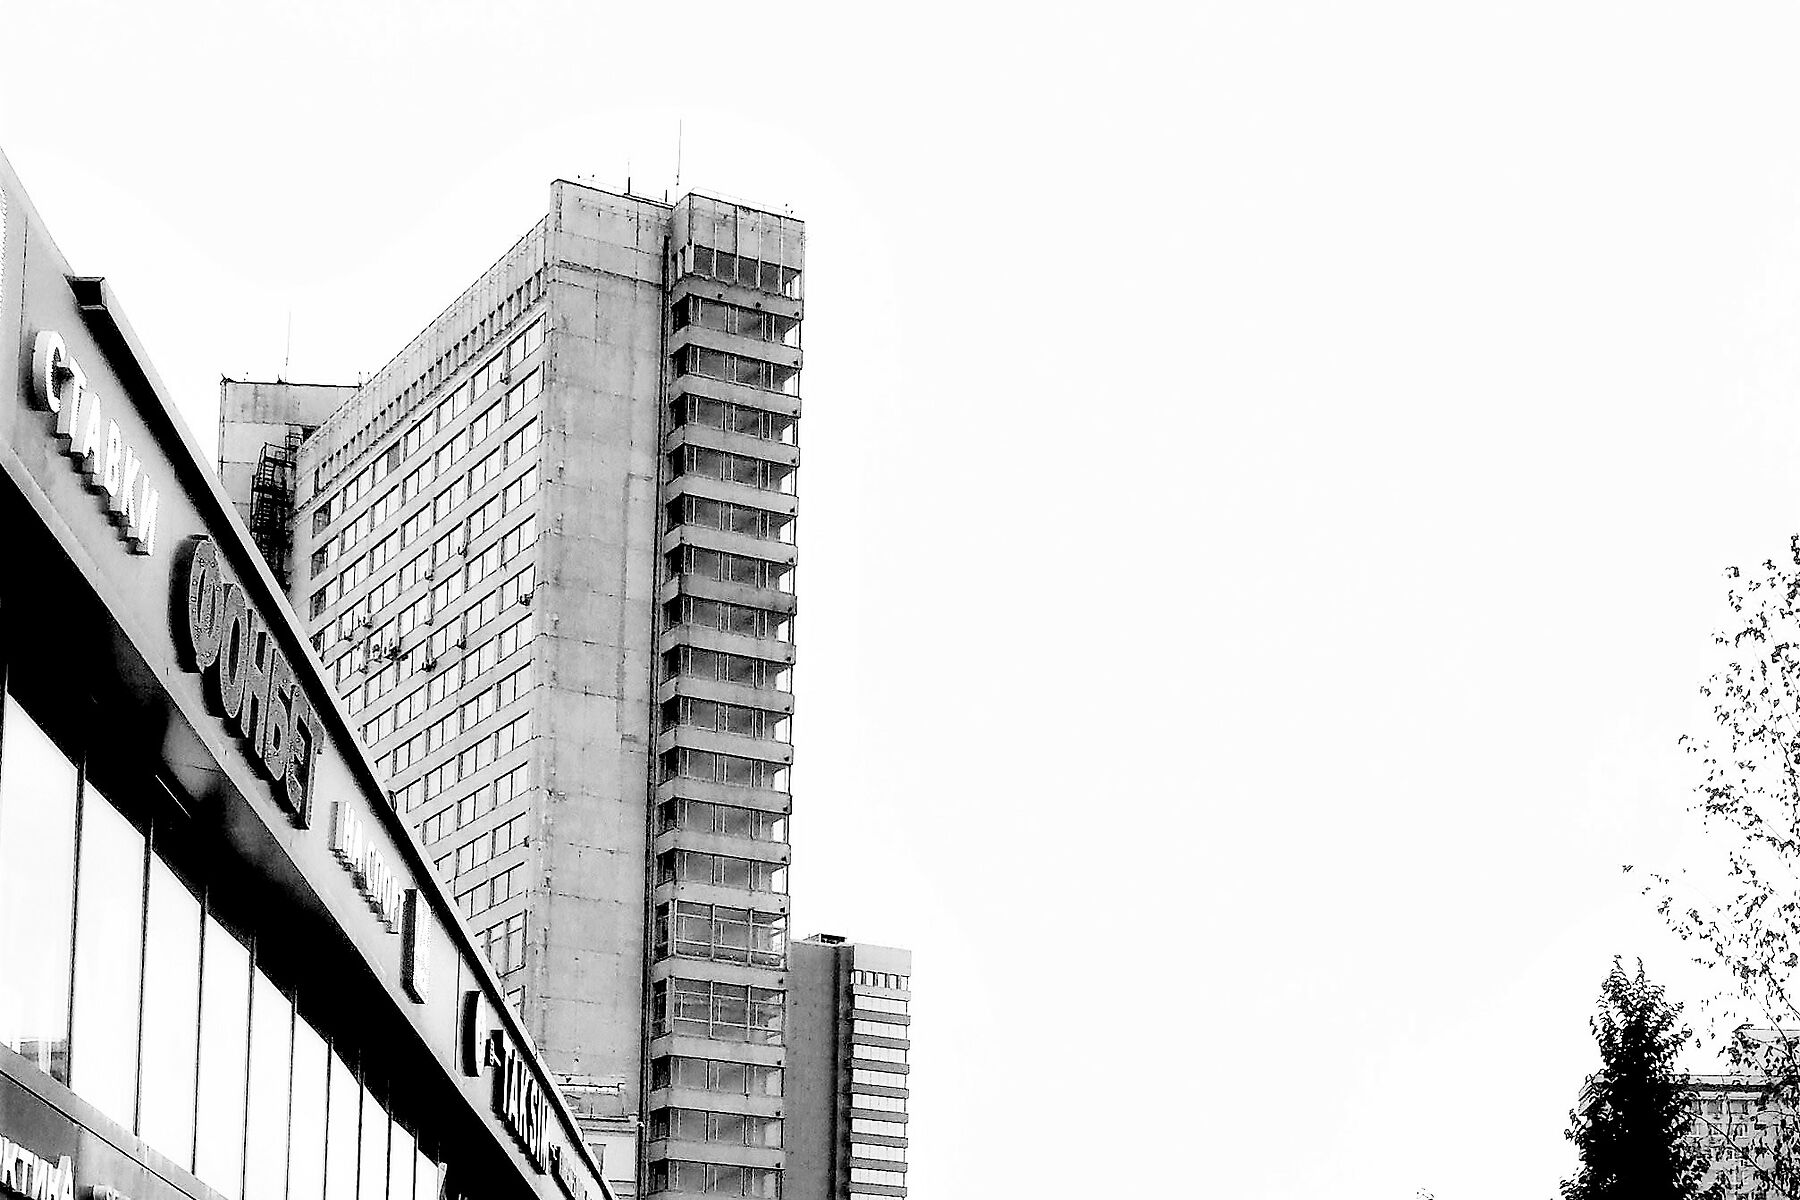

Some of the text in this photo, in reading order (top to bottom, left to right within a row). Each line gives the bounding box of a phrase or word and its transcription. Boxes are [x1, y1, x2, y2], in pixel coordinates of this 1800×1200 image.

[33, 330, 159, 556] СТАВКИ
[184, 535, 327, 831] ФОНБЕТ
[501, 1031, 550, 1173] TAKSIM
